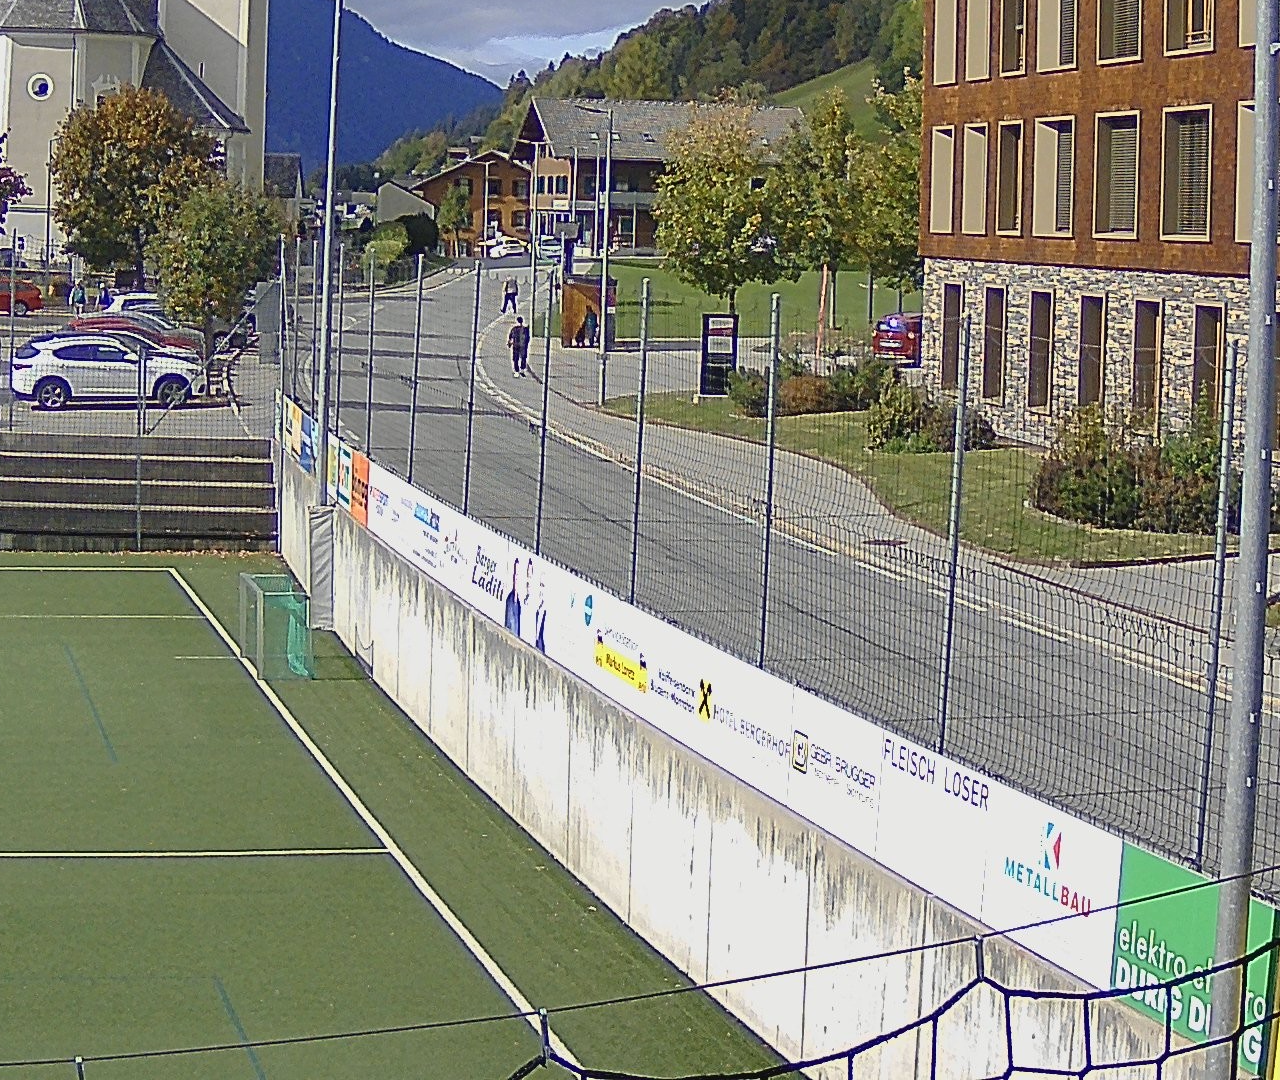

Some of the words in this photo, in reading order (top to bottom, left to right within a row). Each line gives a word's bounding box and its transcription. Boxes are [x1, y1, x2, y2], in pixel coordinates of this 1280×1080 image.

[884, 738, 936, 785] FLEISCH
[944, 767, 989, 812] LOSER
[1004, 856, 1091, 917] METALLBAU
[1119, 920, 1187, 979] elektro
